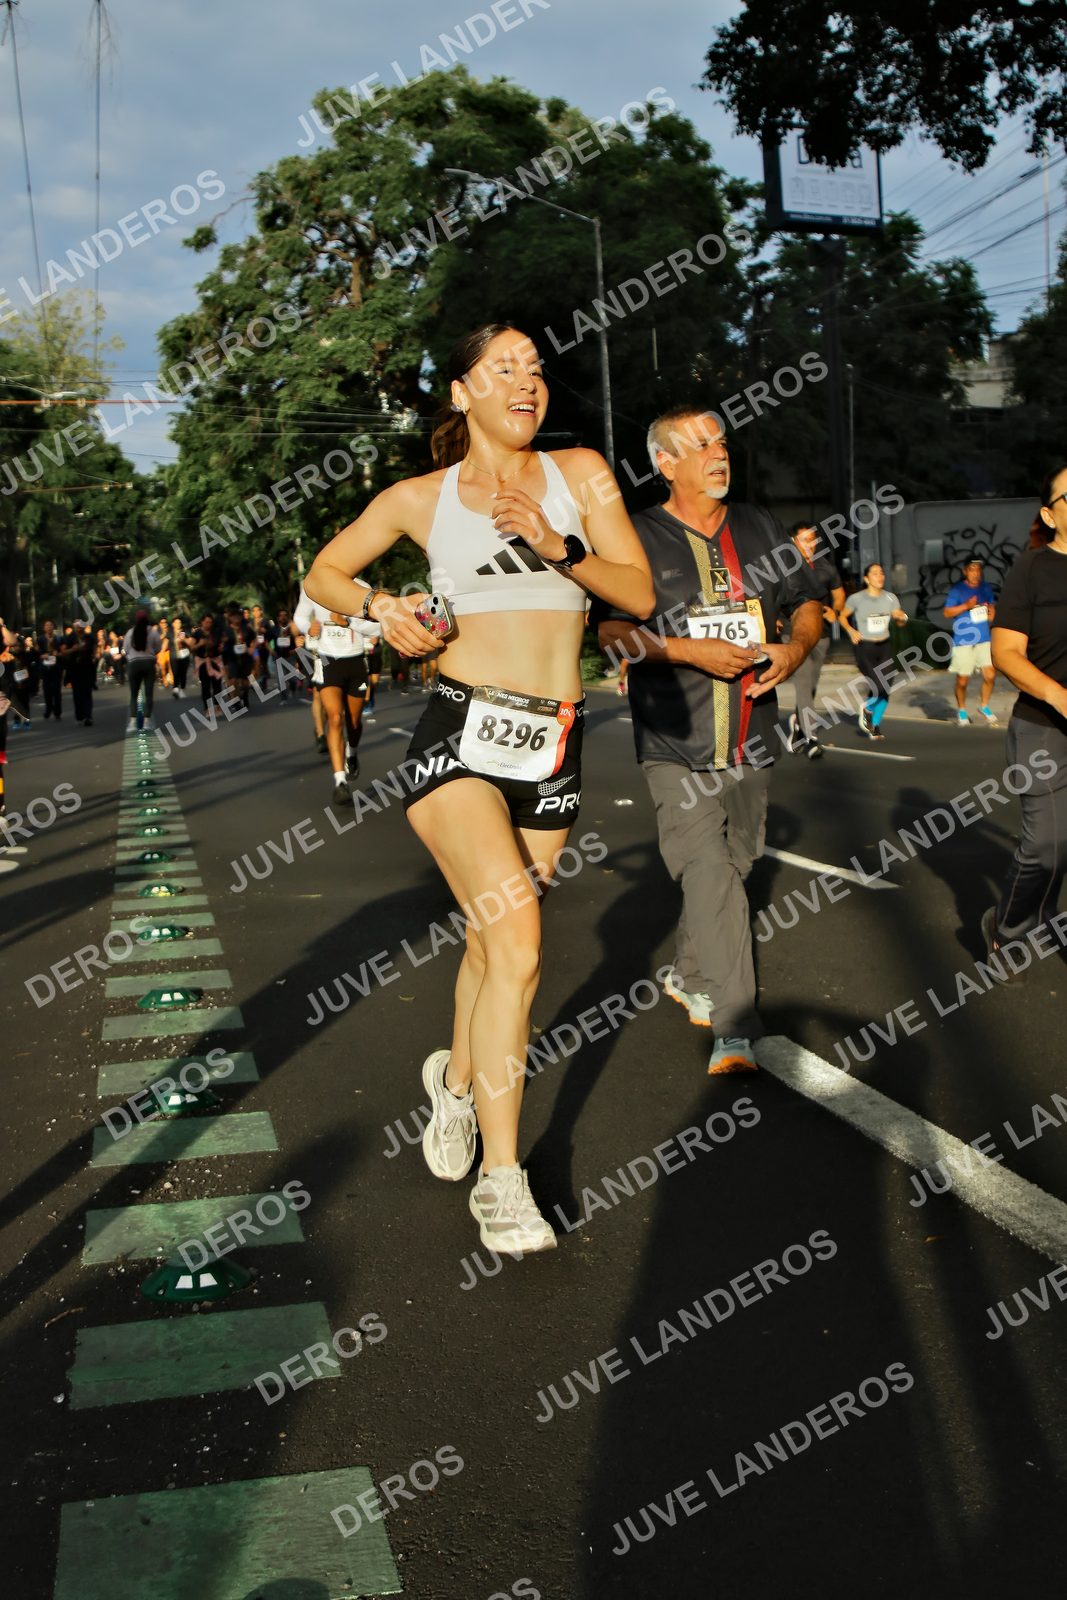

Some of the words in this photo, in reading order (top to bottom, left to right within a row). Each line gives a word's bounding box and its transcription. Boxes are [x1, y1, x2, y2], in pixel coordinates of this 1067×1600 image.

[944, 524, 997, 543] TOY
[700, 620, 749, 640] 7765
[437, 683, 465, 702] PRO
[477, 715, 548, 751] 8296
[415, 756, 468, 784] NIK
